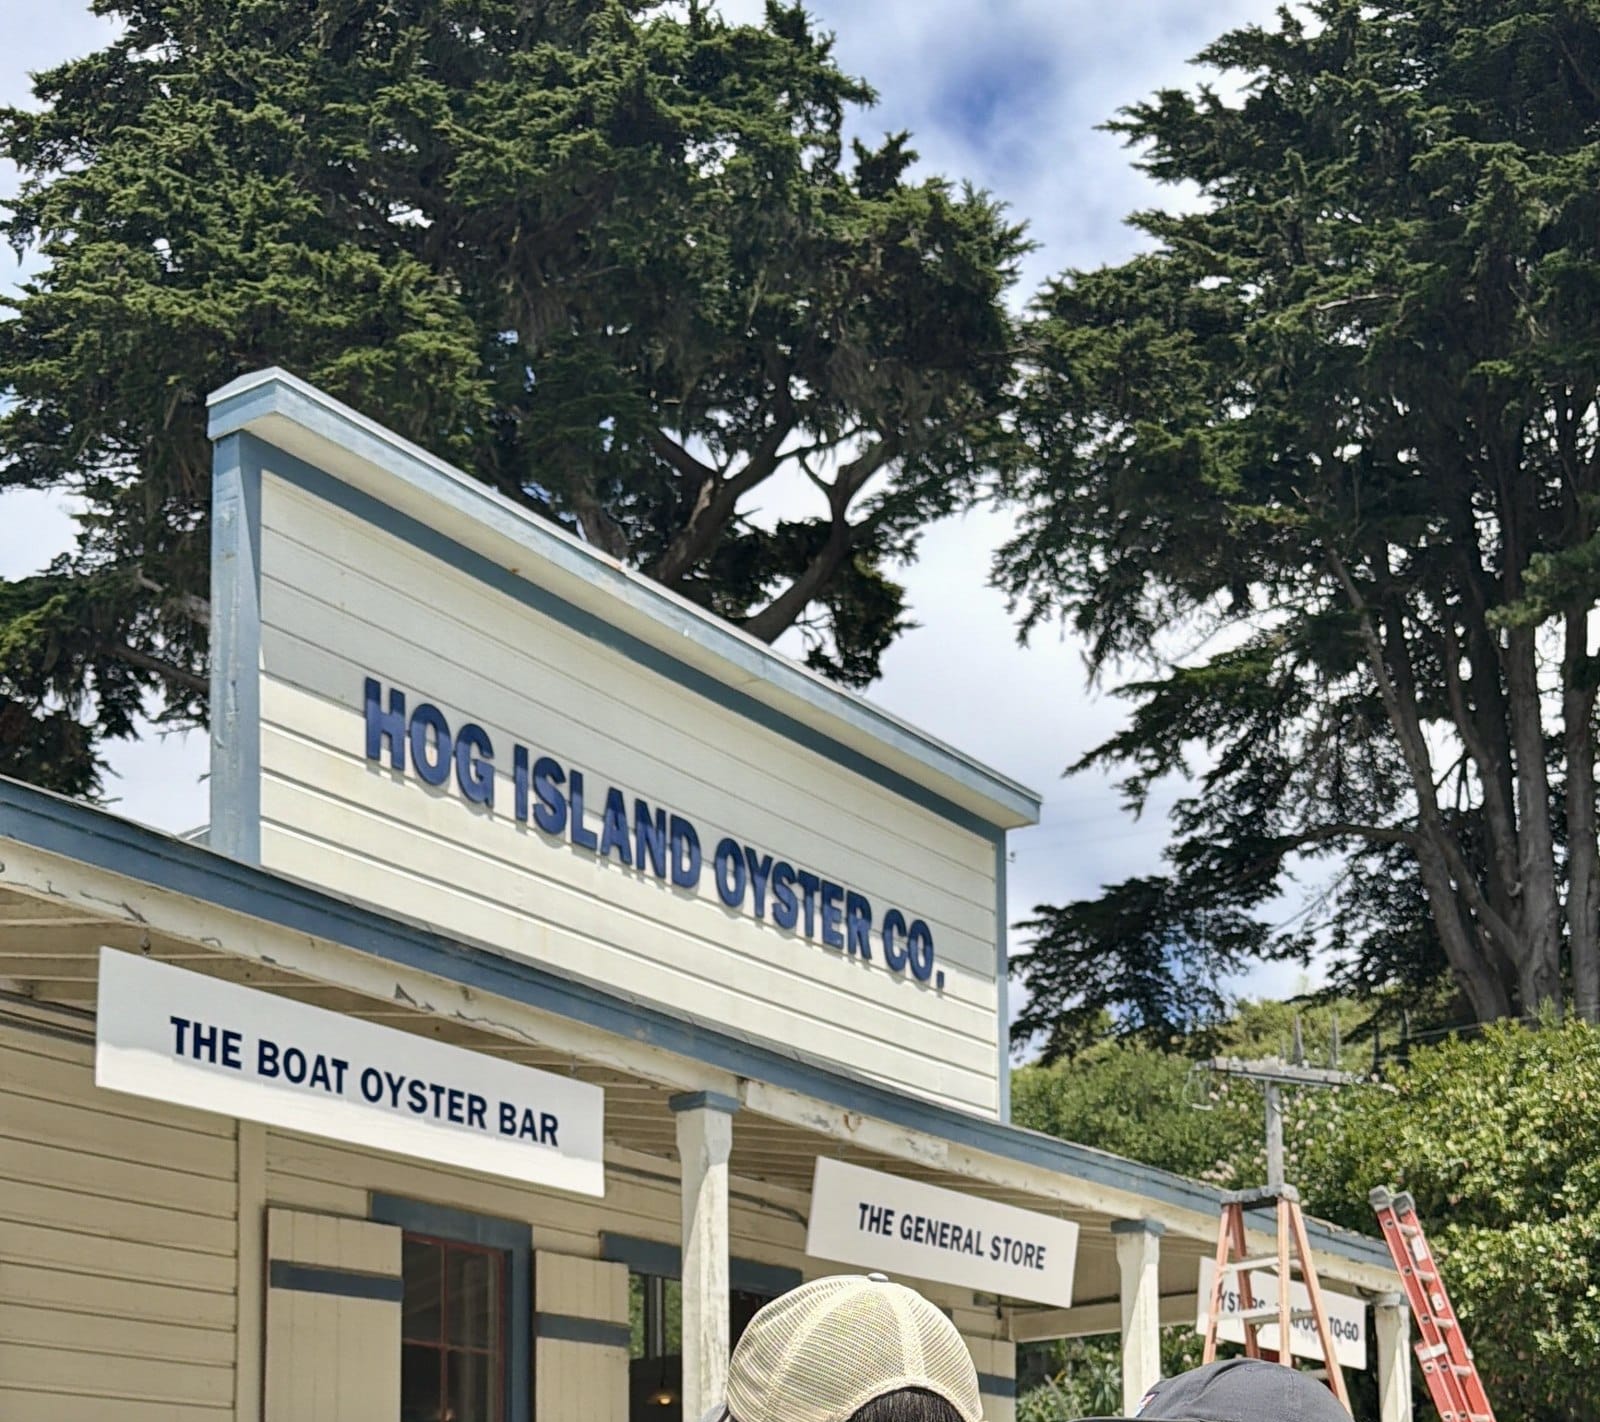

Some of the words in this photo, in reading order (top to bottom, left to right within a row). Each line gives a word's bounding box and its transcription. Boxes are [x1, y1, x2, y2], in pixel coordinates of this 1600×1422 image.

[365, 677, 495, 809] HOG
[514, 744, 700, 888] ISLAND
[714, 838, 872, 960] OYSTER
[883, 909, 945, 988] CO.
[170, 1015, 242, 1070] THE
[258, 1039, 349, 1094] BOAT
[361, 1067, 487, 1130] OYSTER
[499, 1101, 559, 1147] BAR
[859, 1202, 895, 1236] THE
[900, 1213, 984, 1257] GENERAL
[990, 1235, 1046, 1270] STORE
[1328, 1316, 1359, 1342] TO-GO
